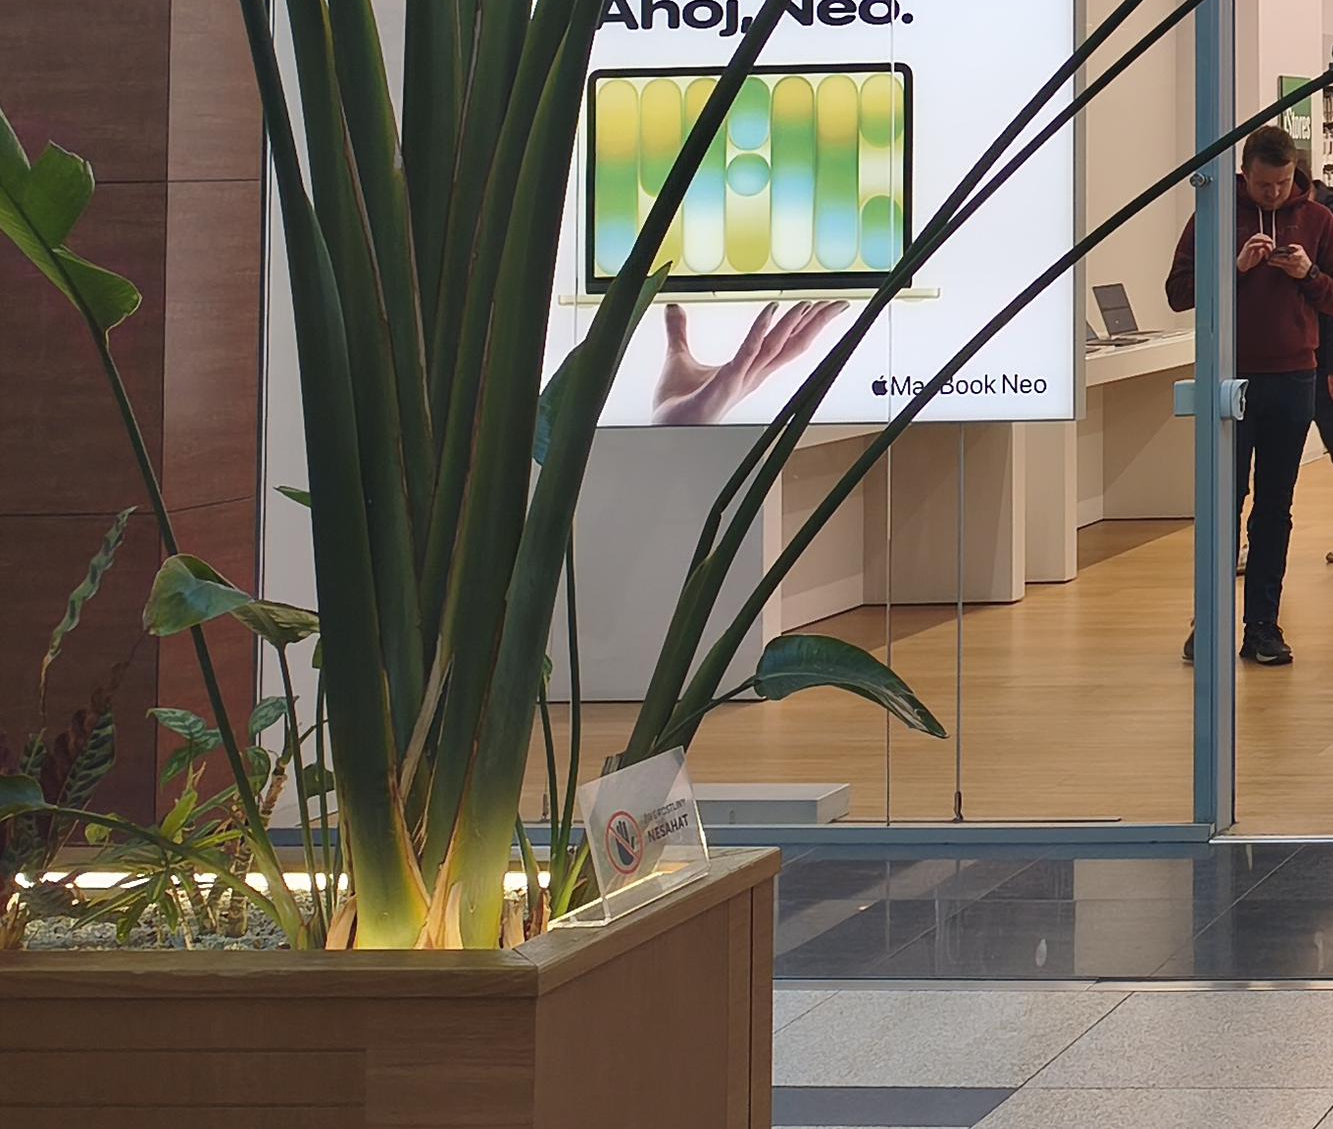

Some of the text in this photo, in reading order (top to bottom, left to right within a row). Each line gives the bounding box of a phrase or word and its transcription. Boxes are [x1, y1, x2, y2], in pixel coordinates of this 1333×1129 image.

[890, 373, 1048, 396] MaBook Neo
[647, 813, 688, 842] NESAHAT
